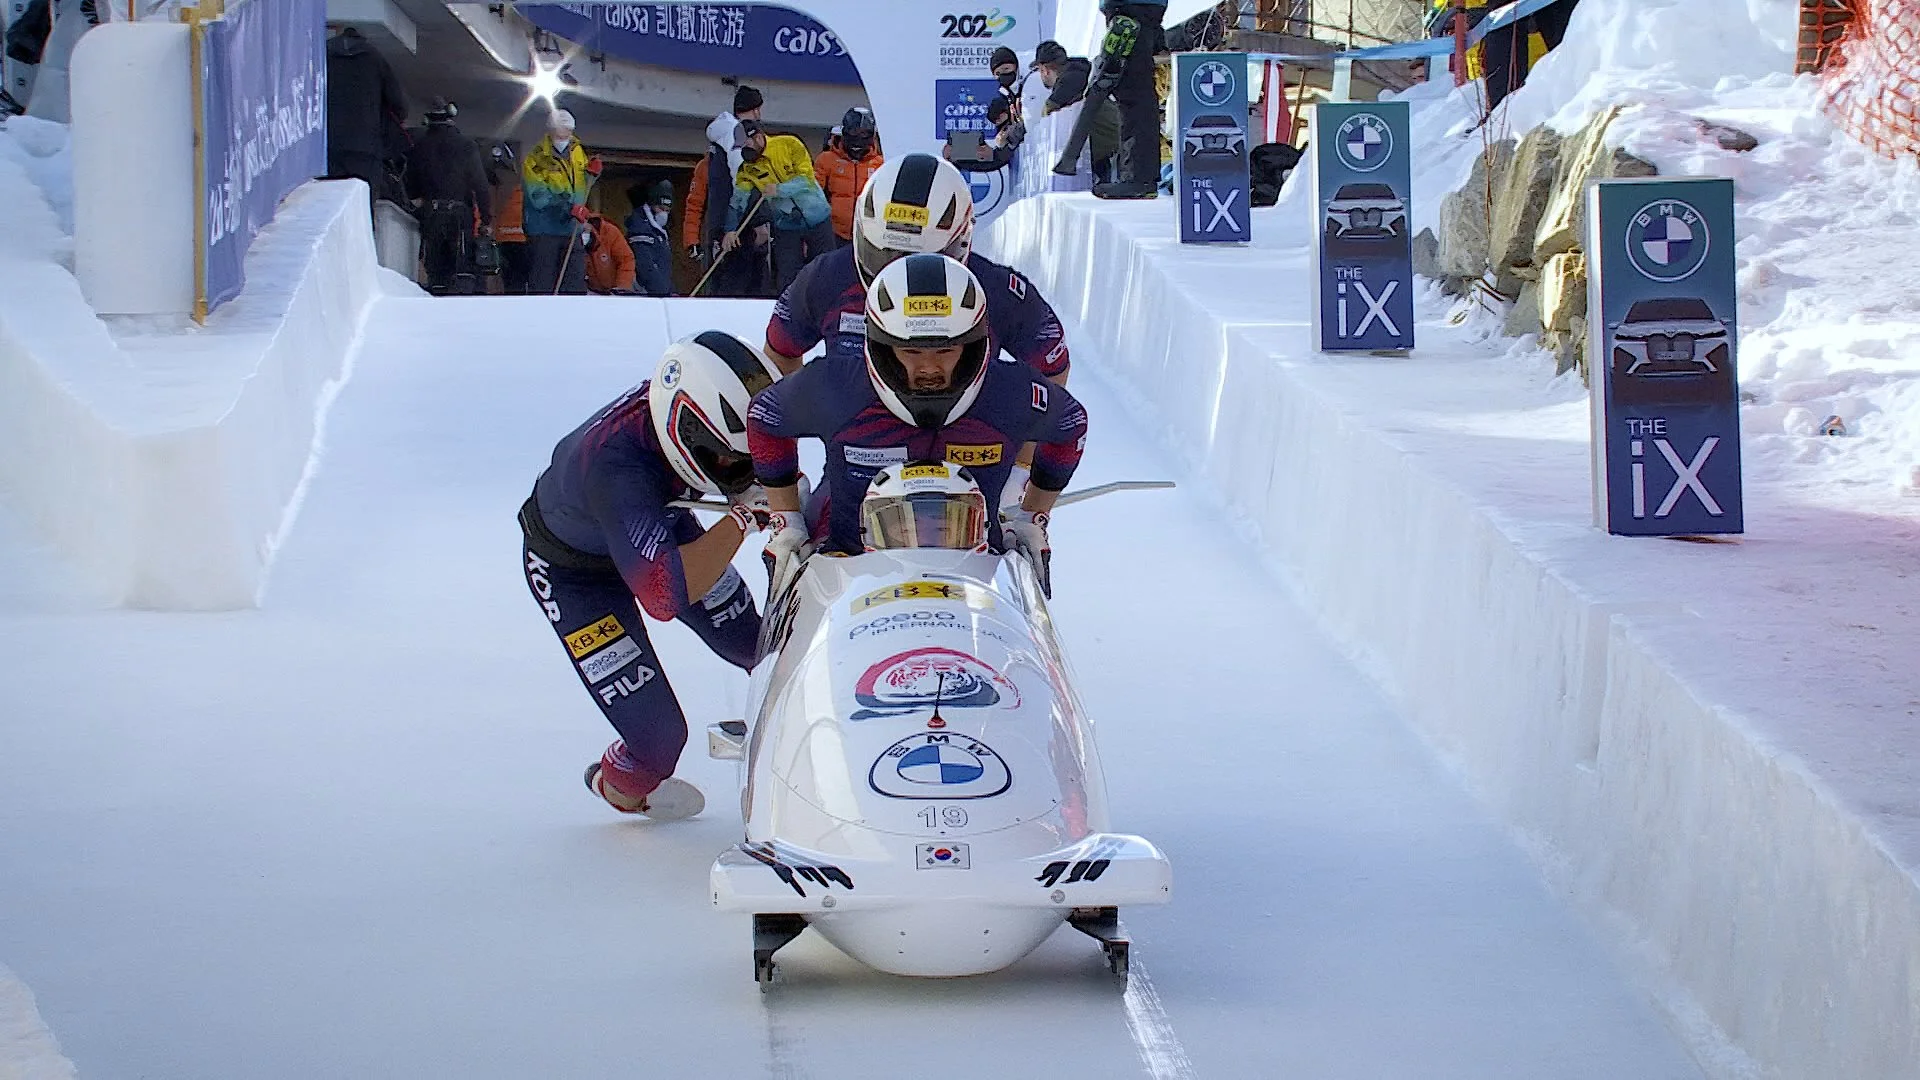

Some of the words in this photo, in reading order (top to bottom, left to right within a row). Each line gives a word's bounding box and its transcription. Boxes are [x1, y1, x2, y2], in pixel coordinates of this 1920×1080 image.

[606, 4, 648, 33] caissa
[774, 27, 847, 56] caiss
[940, 47, 995, 56] BOBSLEIG
[940, 57, 990, 66] SKELETO
[944, 104, 989, 116] caiss
[1191, 180, 1213, 188] THE
[1193, 189, 1241, 232] iX
[1334, 267, 1362, 279] THE
[1337, 281, 1401, 337] iX
[1625, 419, 1667, 434] THE
[1631, 437, 1724, 518] iX
[528, 551, 561, 623] KOR
[710, 586, 752, 628] FILA
[599, 664, 656, 706] FILA
[887, 735, 992, 758] BMW
[917, 805, 969, 828] 19
